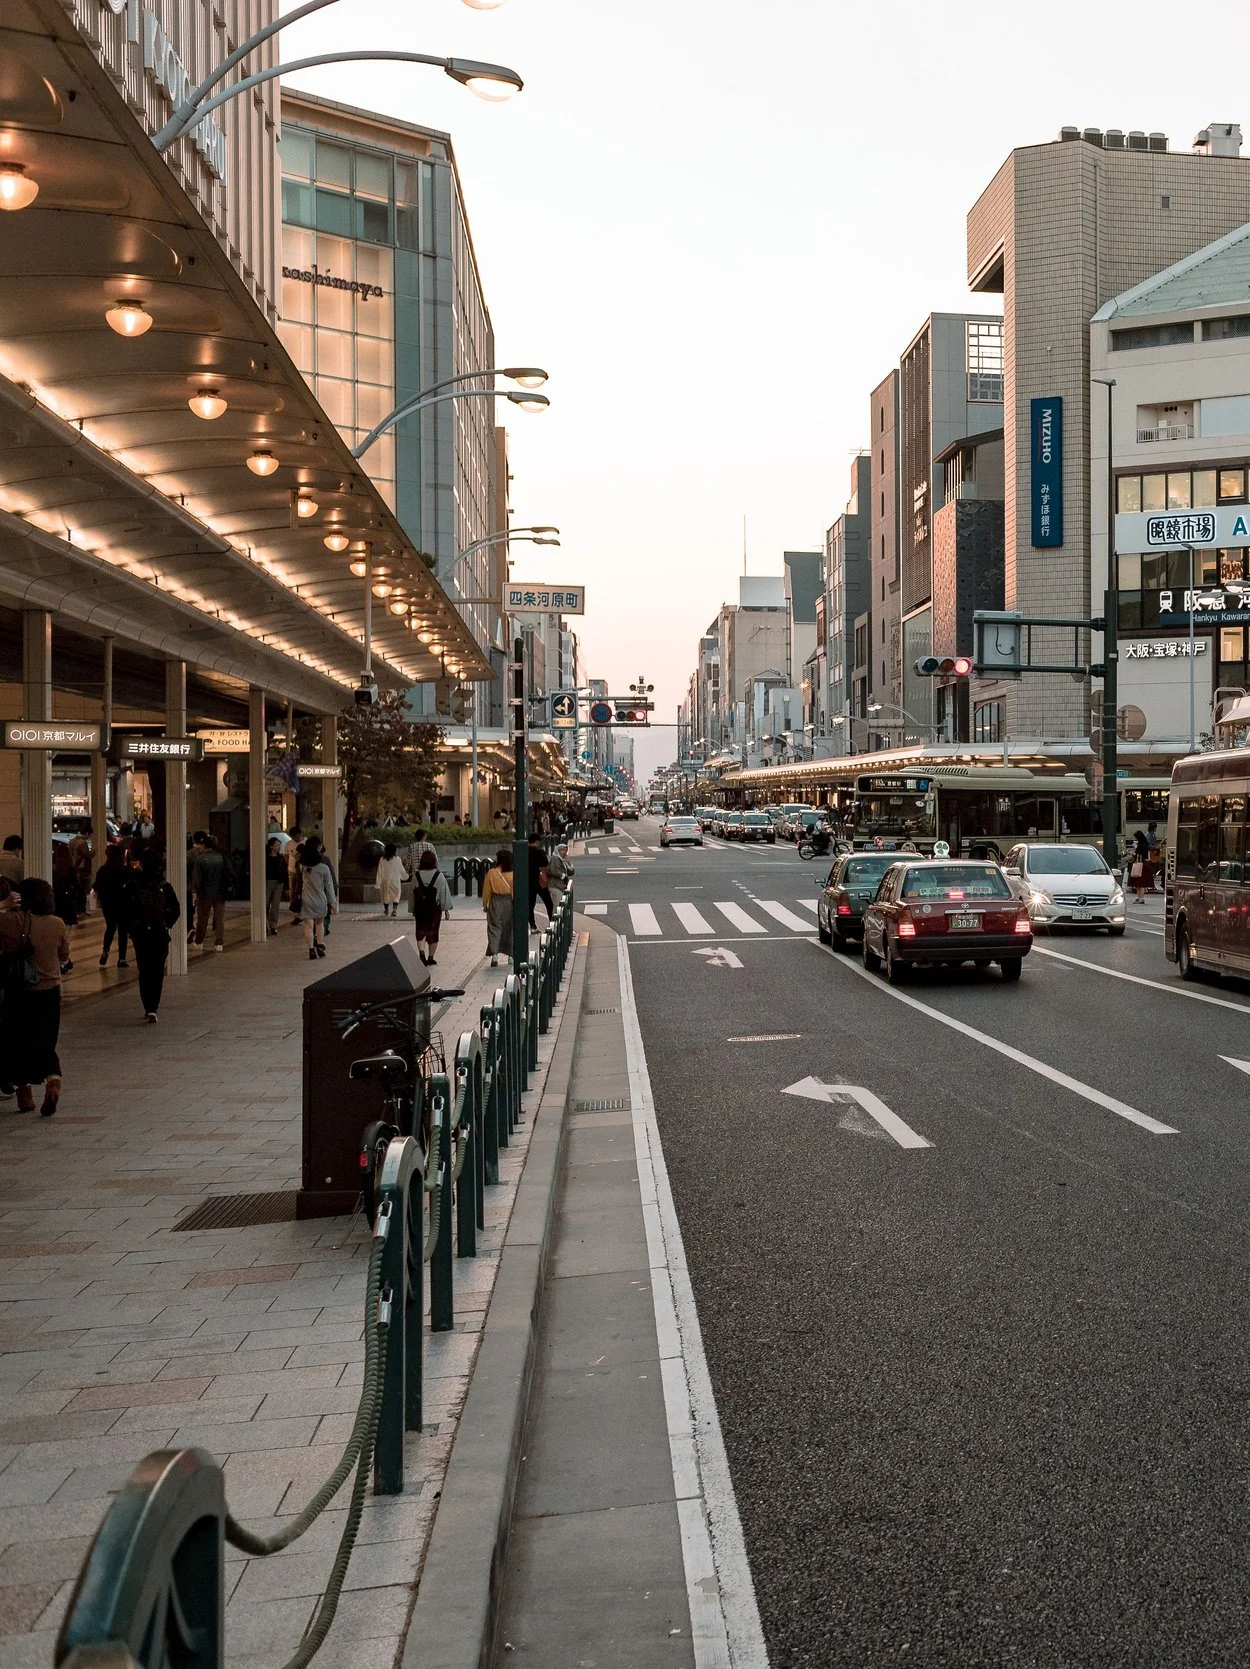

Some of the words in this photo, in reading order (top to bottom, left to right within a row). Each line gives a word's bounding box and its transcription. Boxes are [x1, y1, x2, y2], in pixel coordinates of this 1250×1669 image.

[1042, 408, 1052, 463] MIZUHO
[1041, 484, 1050, 536] みずほ銀行
[1150, 516, 1212, 543] 眼鏡市場
[510, 591, 578, 608] 四条河原町
[43, 730, 96, 742] 京都マルイ
[128, 743, 190, 755] 三井住友銀行
